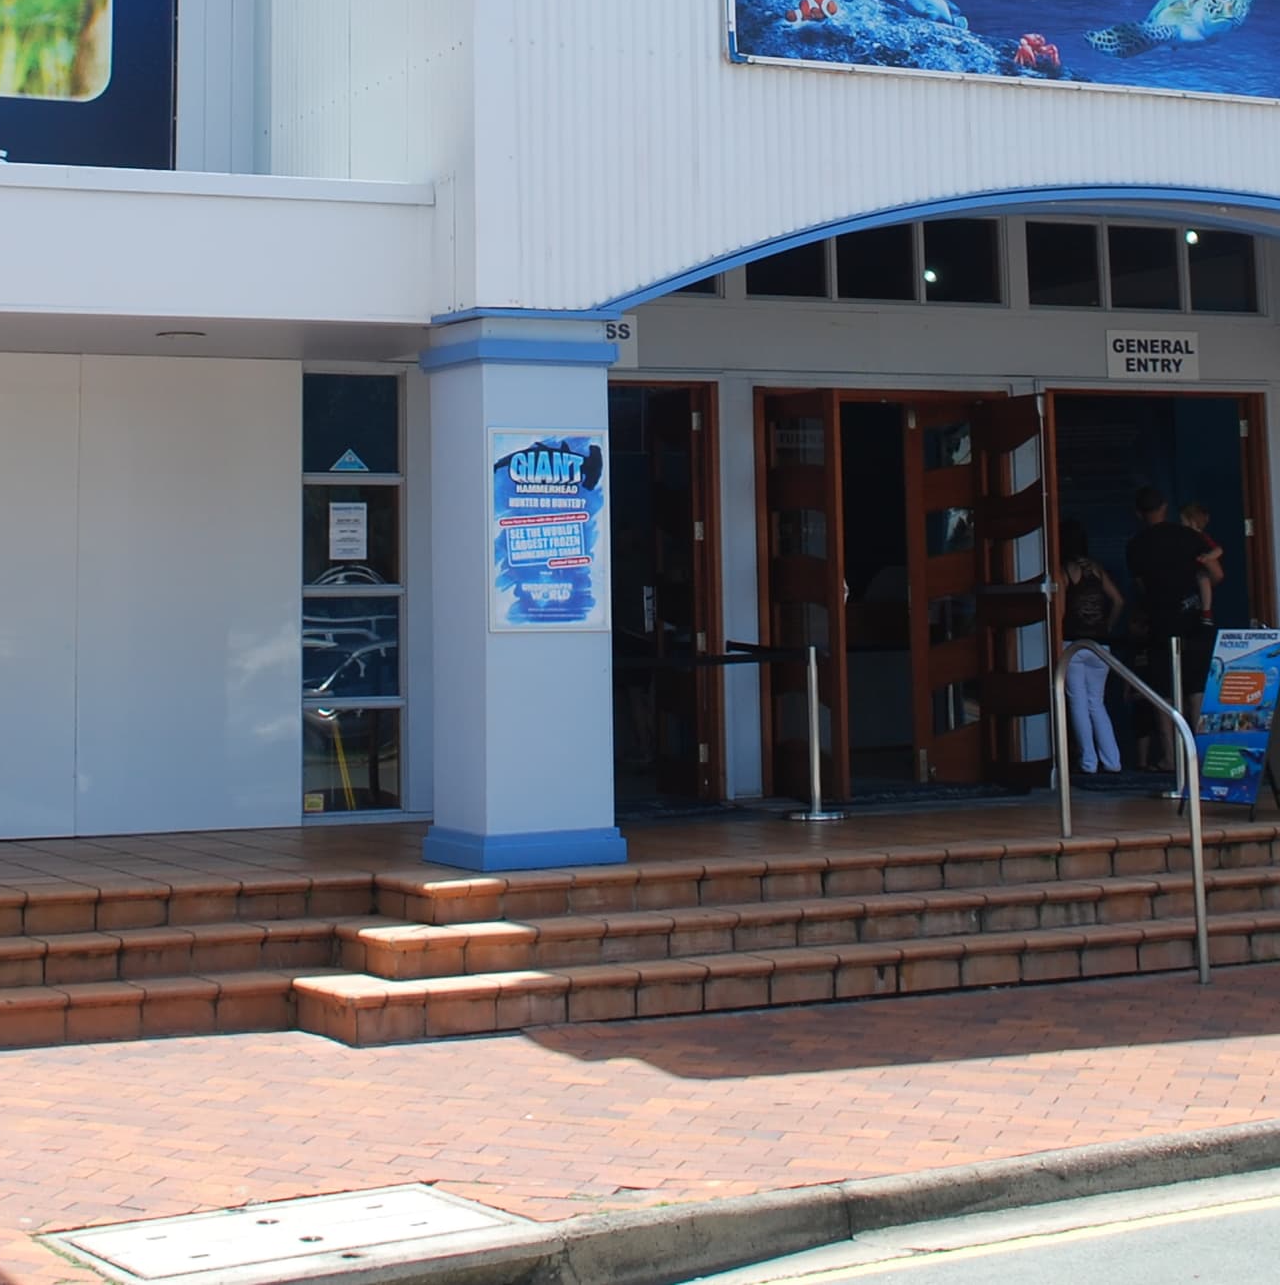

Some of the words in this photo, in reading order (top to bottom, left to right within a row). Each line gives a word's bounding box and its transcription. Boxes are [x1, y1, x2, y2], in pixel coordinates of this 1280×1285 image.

[1112, 339, 1194, 354] GENERAL
[1125, 358, 1183, 373] ENTRY
[510, 450, 584, 484] GIANT
